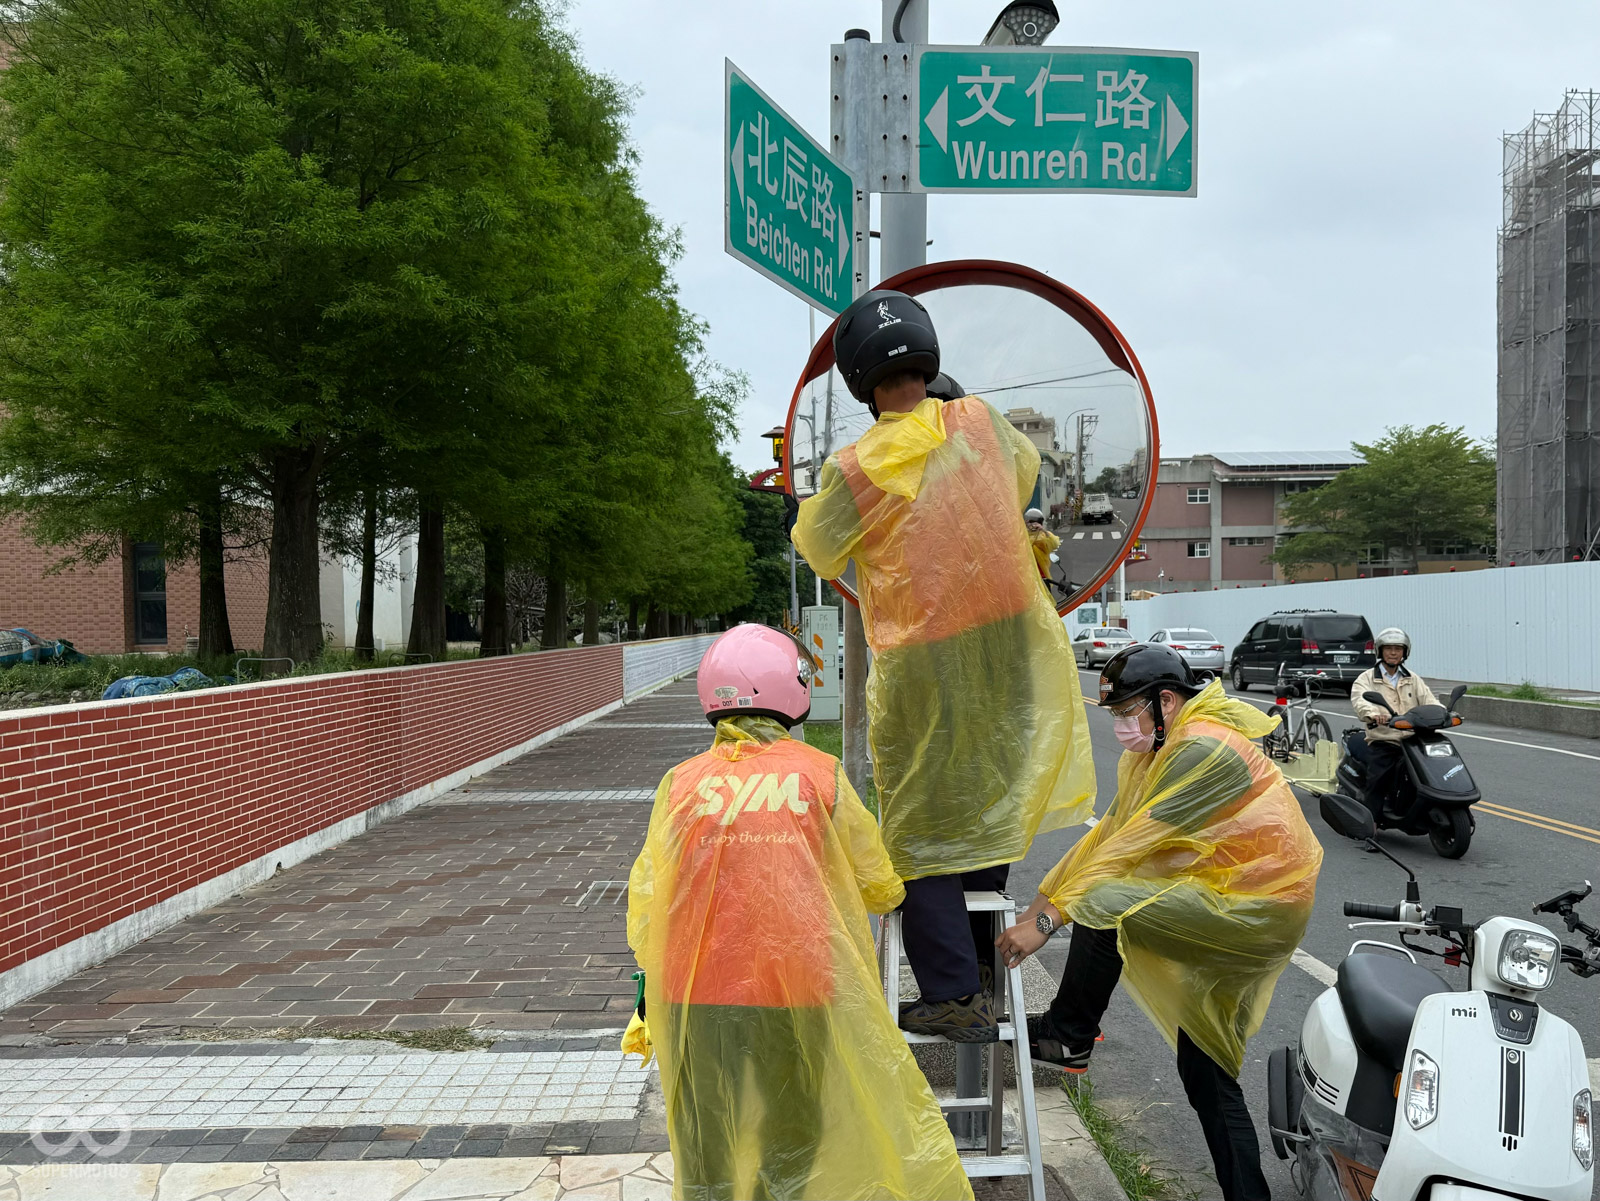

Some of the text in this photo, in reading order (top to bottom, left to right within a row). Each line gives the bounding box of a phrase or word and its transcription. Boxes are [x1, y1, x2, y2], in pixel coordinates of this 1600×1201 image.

[956, 64, 1157, 131] 文仁路
[746, 110, 838, 243] 北辰路
[952, 140, 1158, 182] Wunren Rd.
[745, 198, 839, 301] Beichen Rd.
[877, 318, 902, 329] ZEUS
[695, 772, 810, 826] SYM
[699, 830, 797, 848] Enjoy the ride
[1451, 1006, 1478, 1019] mii
